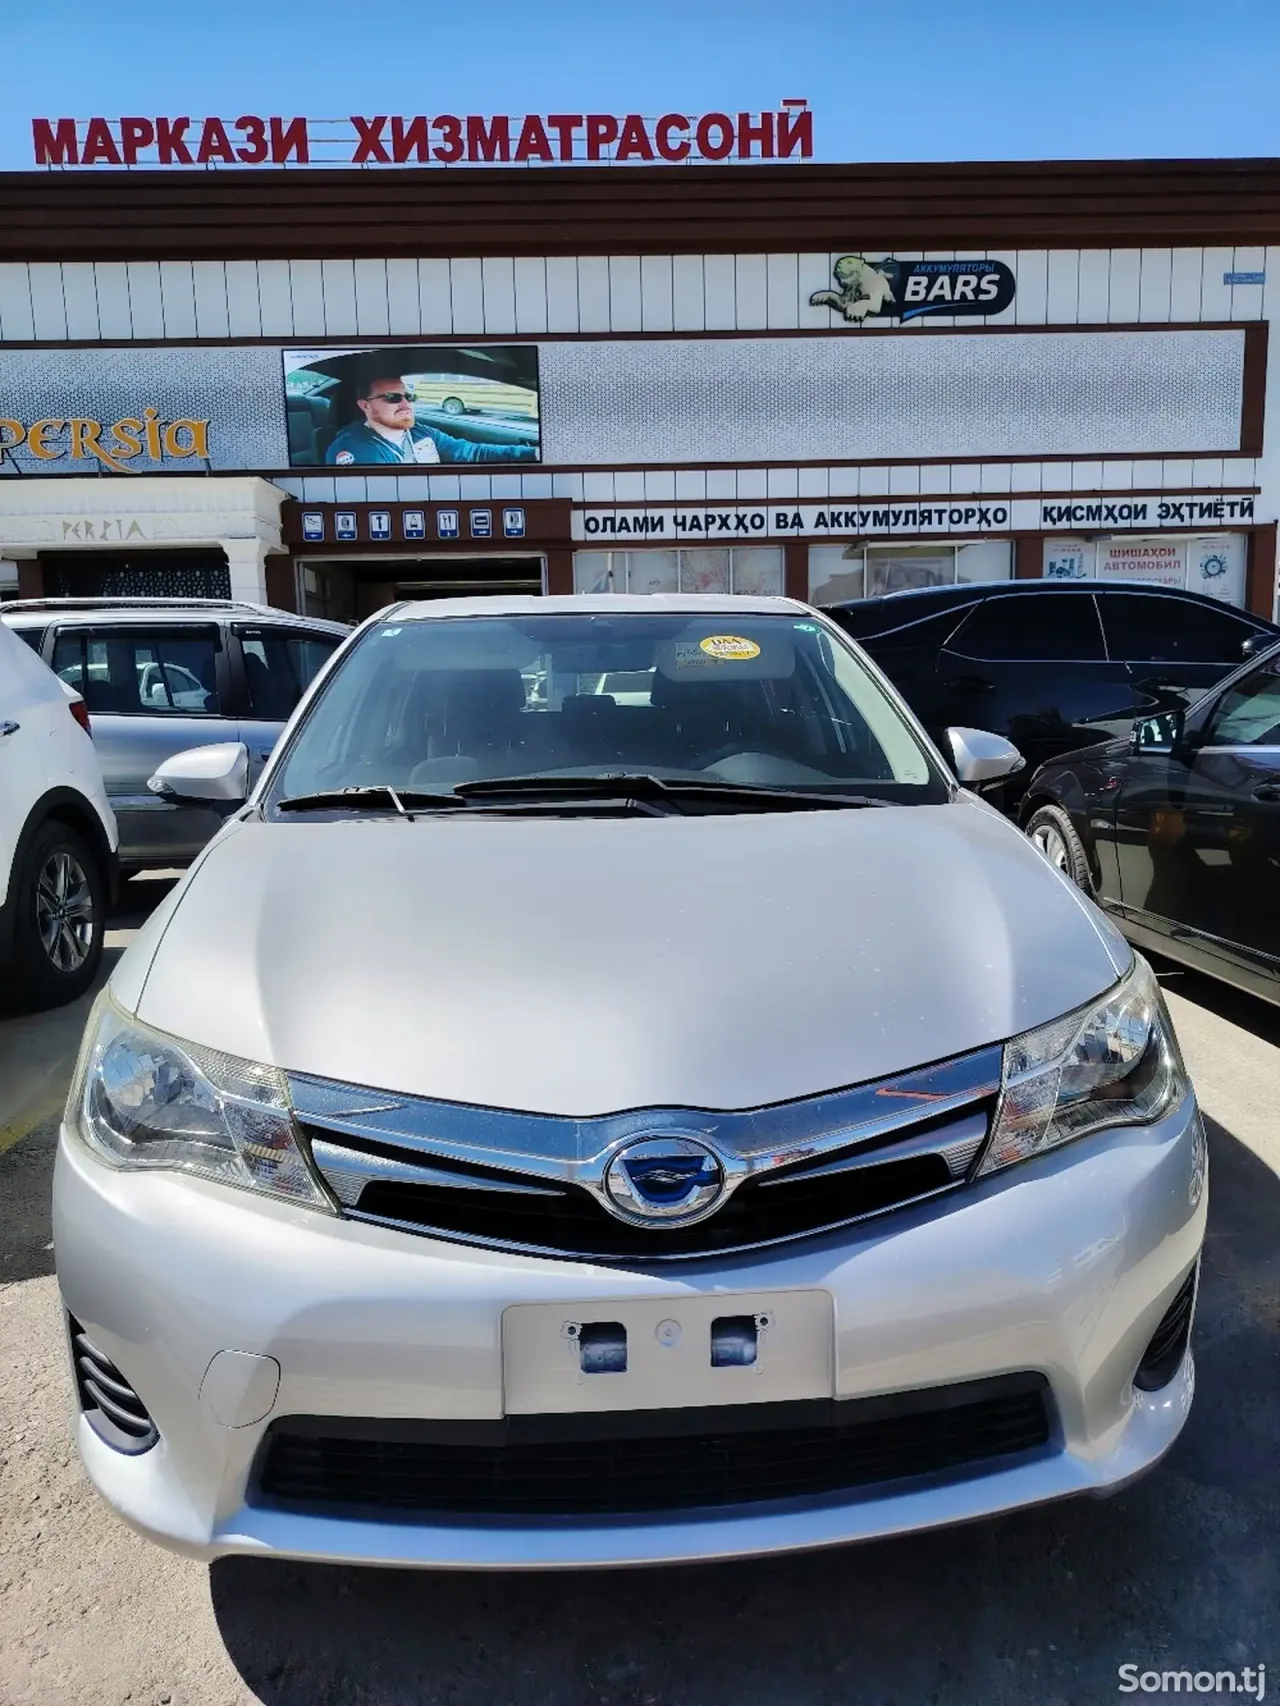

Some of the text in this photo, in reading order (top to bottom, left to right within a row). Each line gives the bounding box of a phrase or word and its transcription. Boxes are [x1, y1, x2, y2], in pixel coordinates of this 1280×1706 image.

[32, 98, 813, 165] МАРКАЗИ ХИЗМАТРАСОНӢ
[913, 263, 996, 273] АККУМУЛЯТОРЫ
[904, 274, 1000, 302] BARS
[585, 507, 1008, 533] ОЛАМИ ЧАРХҲО ВА АККУМУЛЯТОРҲО
[1043, 498, 1254, 525] ҚИСМҲОИ ЭҲТИЁТӢ
[1104, 560, 1180, 571] АВТОМОБИЛ
